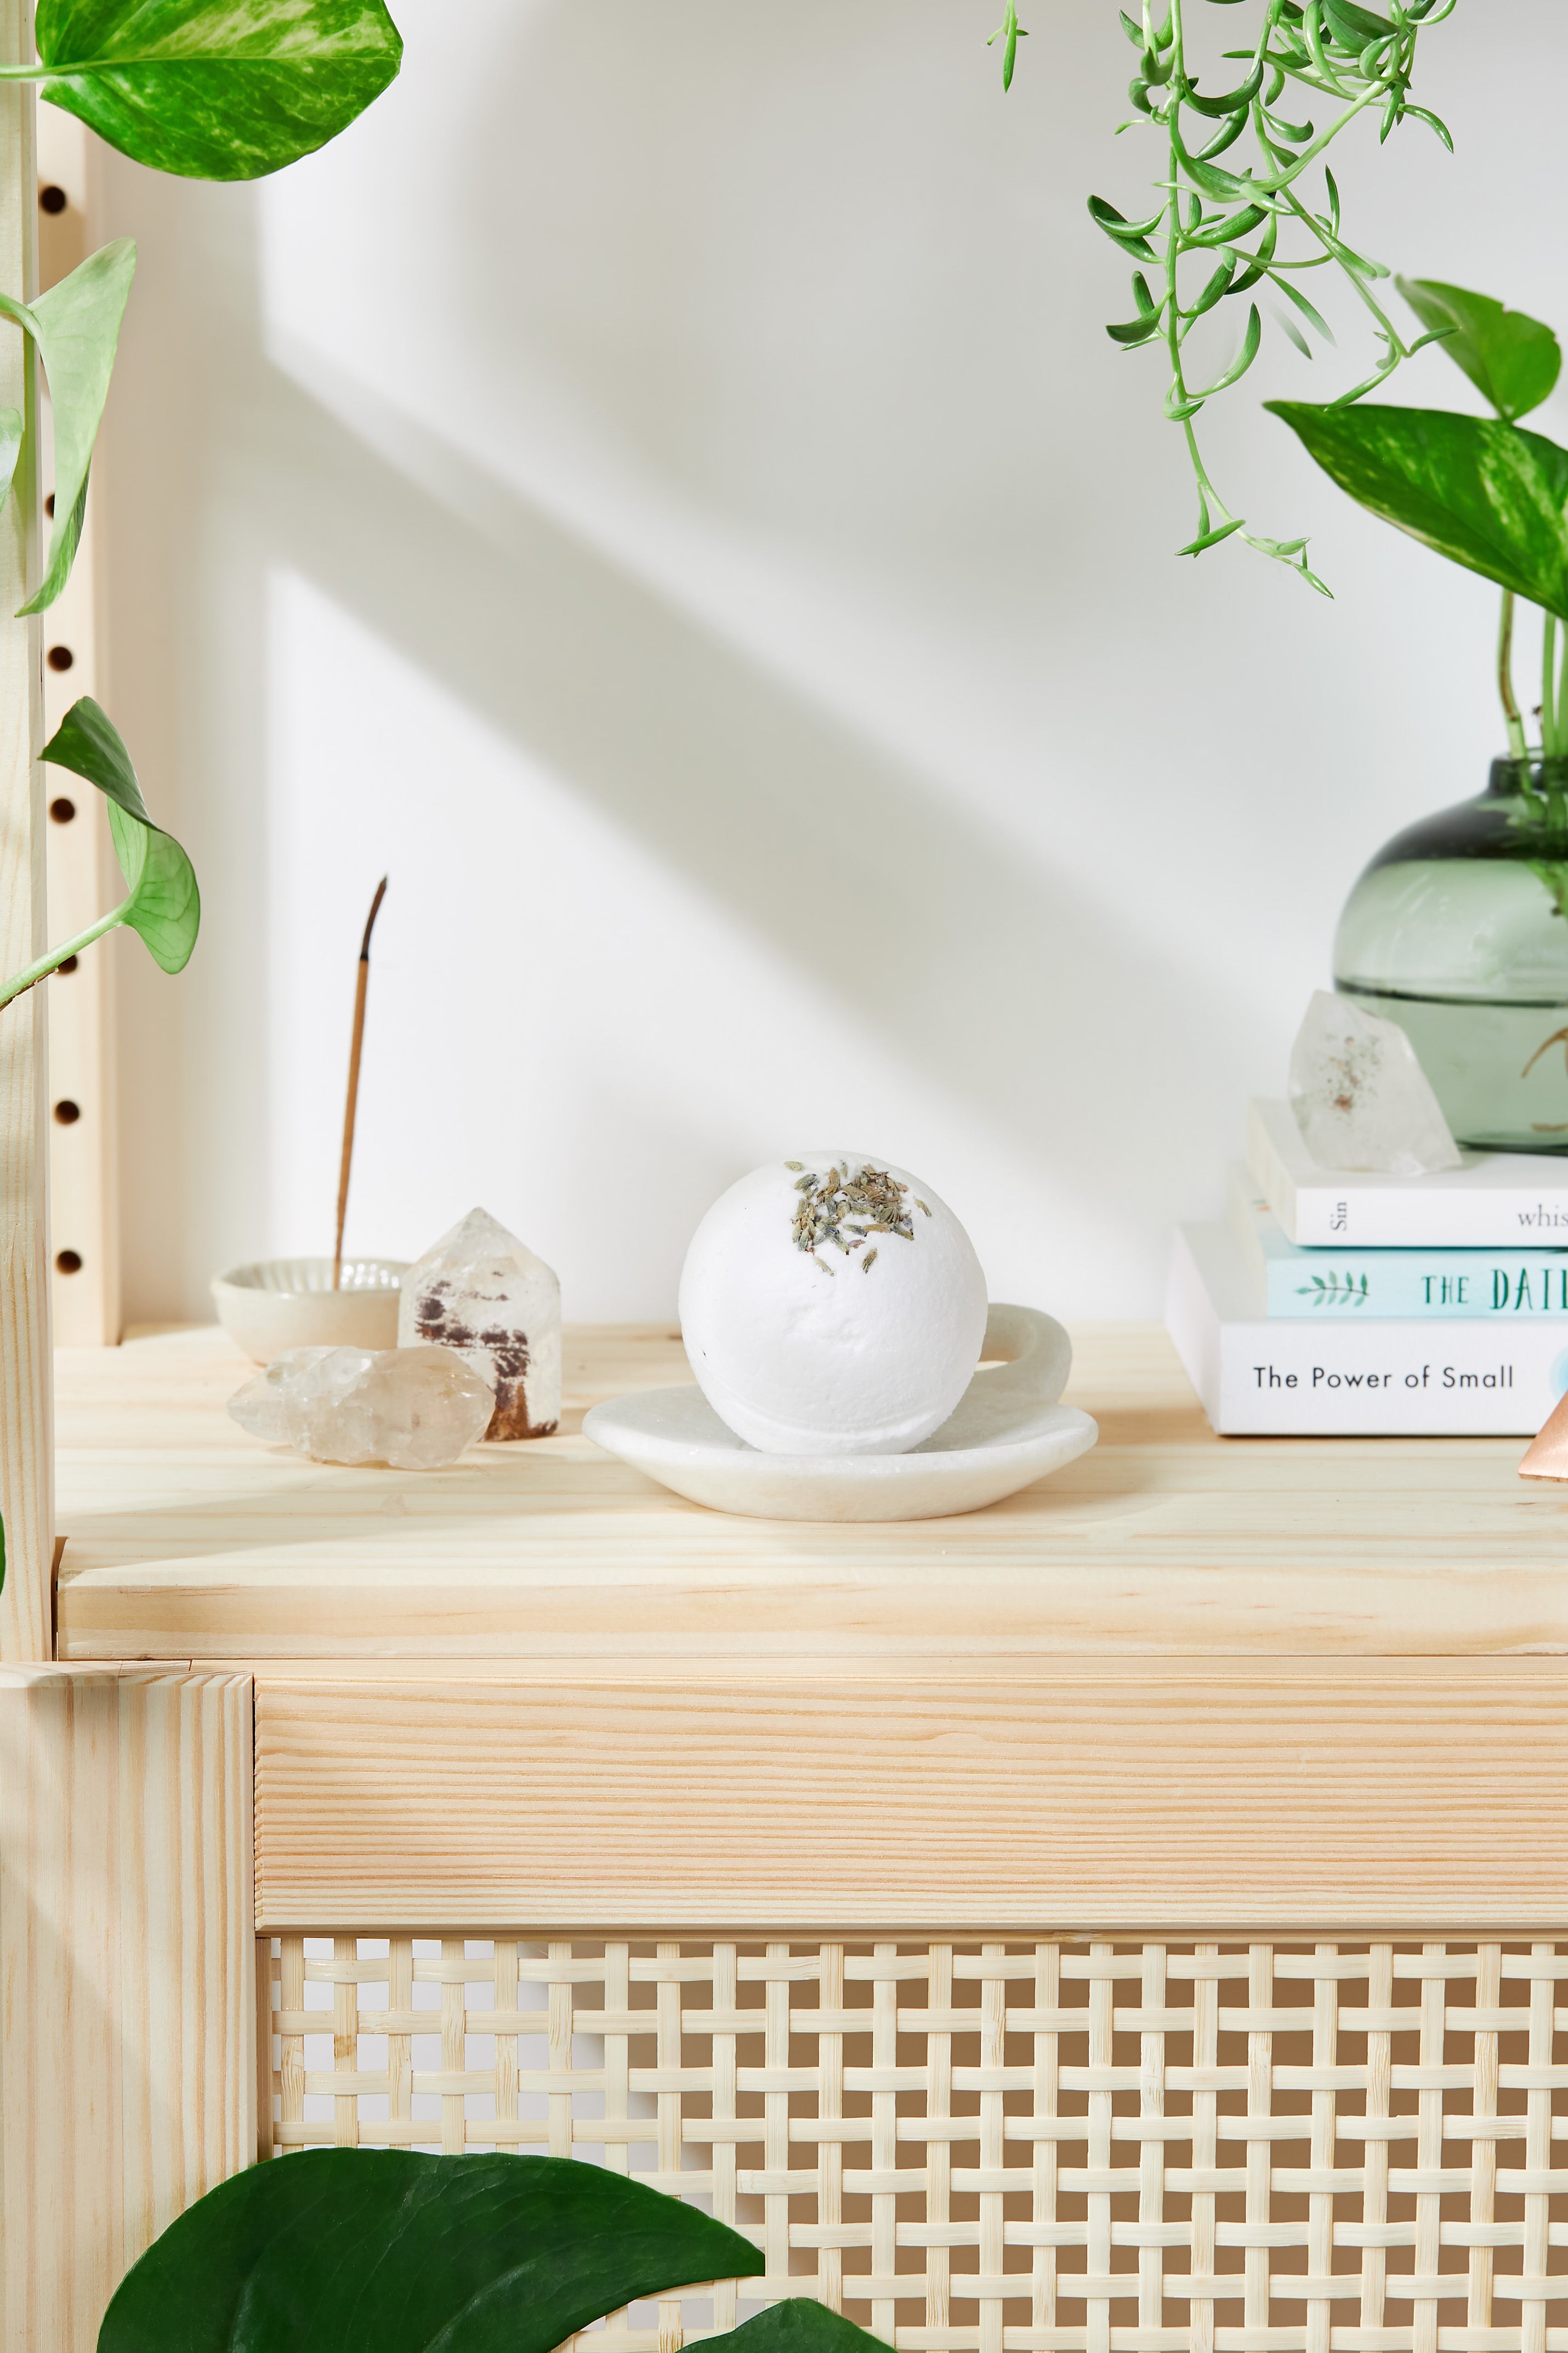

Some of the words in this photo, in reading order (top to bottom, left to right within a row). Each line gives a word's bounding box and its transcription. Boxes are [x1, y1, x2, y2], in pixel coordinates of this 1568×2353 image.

[1330, 1201, 1348, 1232] Sin
[1422, 1275, 1470, 1305] THE
[1253, 1365, 1299, 1389] The
[1313, 1367, 1393, 1389] Power
[1405, 1365, 1430, 1389] of
[1442, 1365, 1513, 1389] Small
